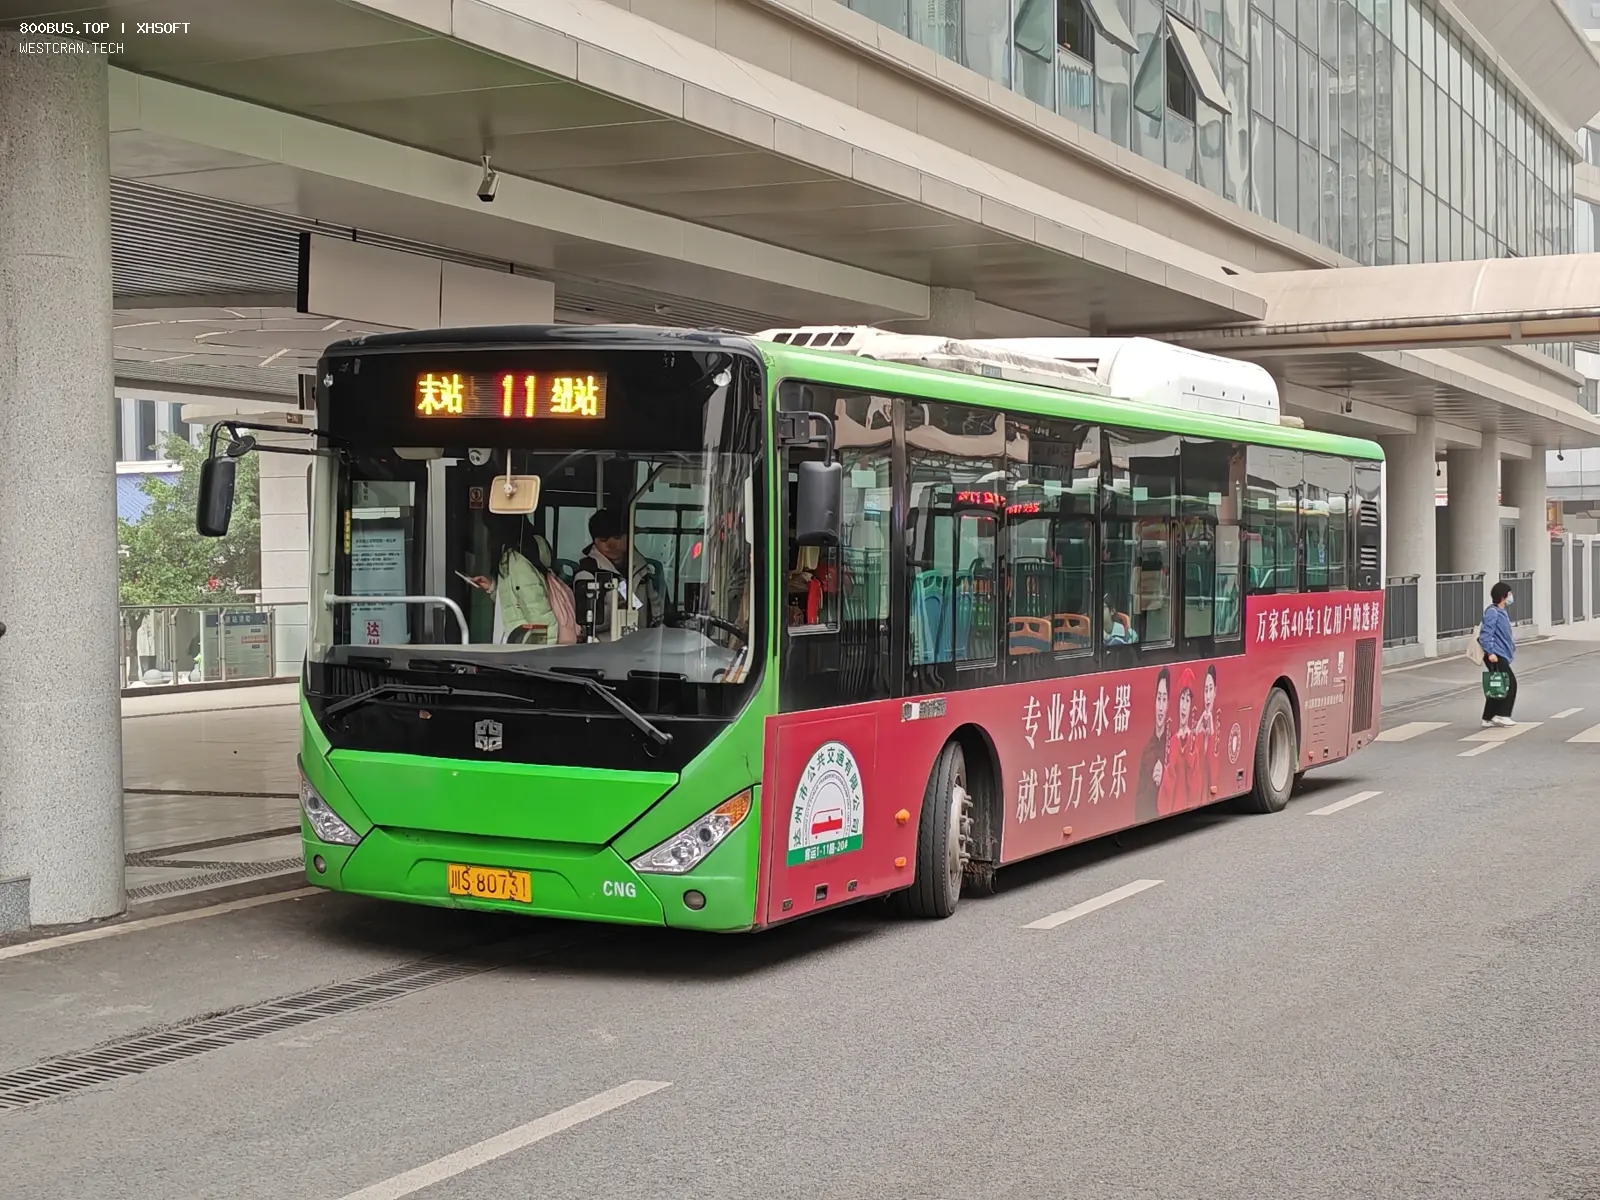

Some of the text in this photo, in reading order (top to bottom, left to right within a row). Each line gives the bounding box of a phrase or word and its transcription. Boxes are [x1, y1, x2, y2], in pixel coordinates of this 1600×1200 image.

[502, 375, 535, 417] 11
[1256, 601, 1380, 643] 万家乐40年1亿用户的选择
[1021, 683, 1132, 750] 专业热水器
[1016, 748, 1128, 824] 就选万家乐
[602, 880, 637, 898] CNG
